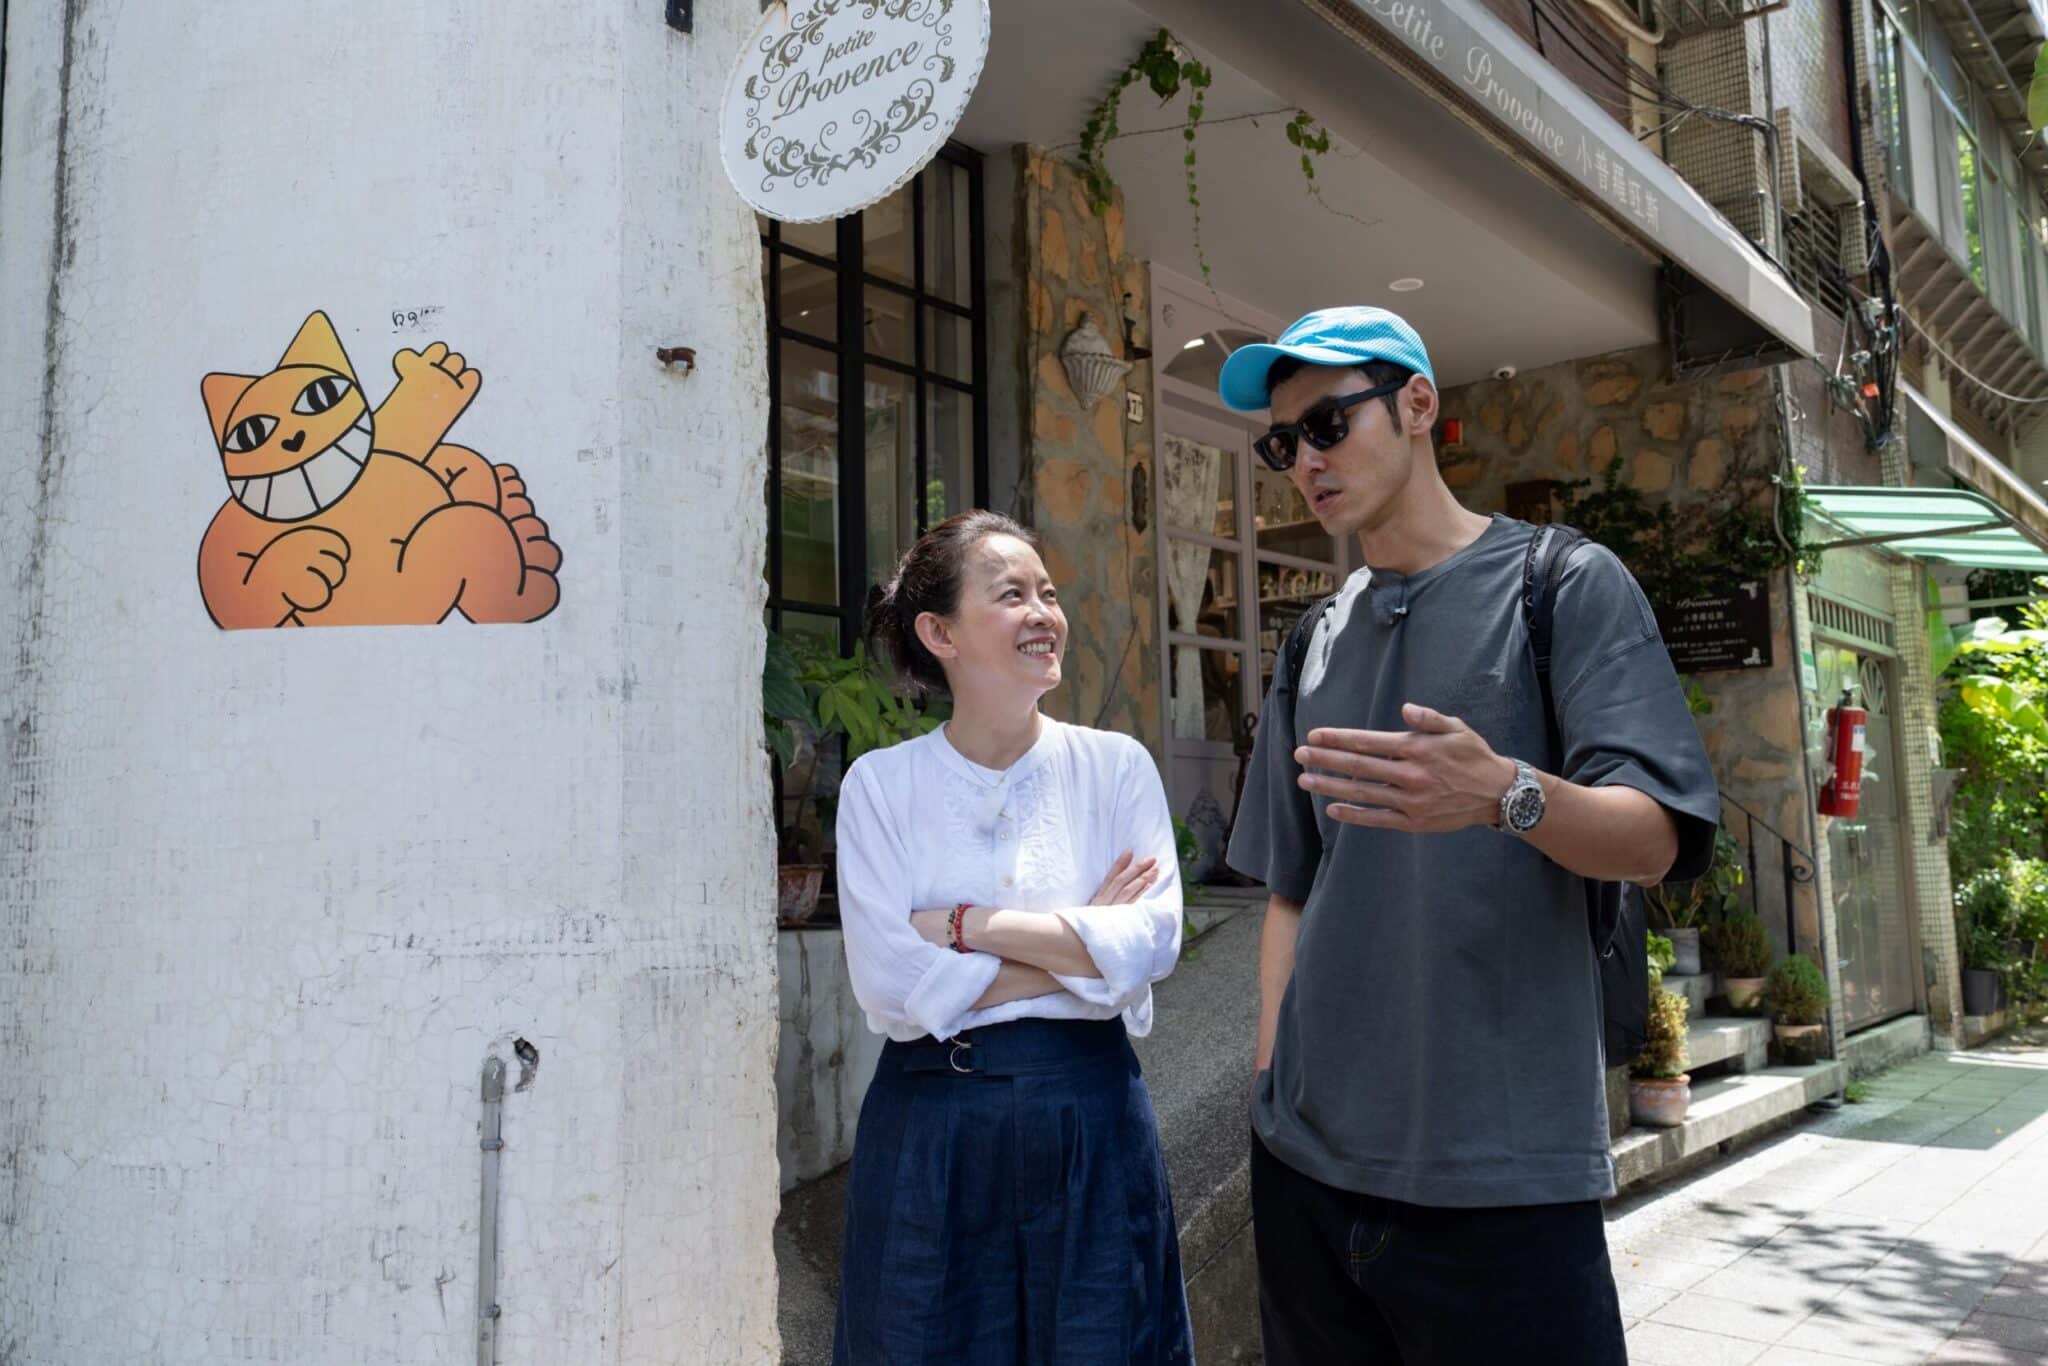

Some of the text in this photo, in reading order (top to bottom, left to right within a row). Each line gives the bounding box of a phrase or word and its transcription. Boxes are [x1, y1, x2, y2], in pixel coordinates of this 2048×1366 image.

[772, 40, 925, 121] Provence
[818, 29, 877, 76] petite
[1367, 0, 1448, 60] etite
[1463, 46, 1568, 157] Provence
